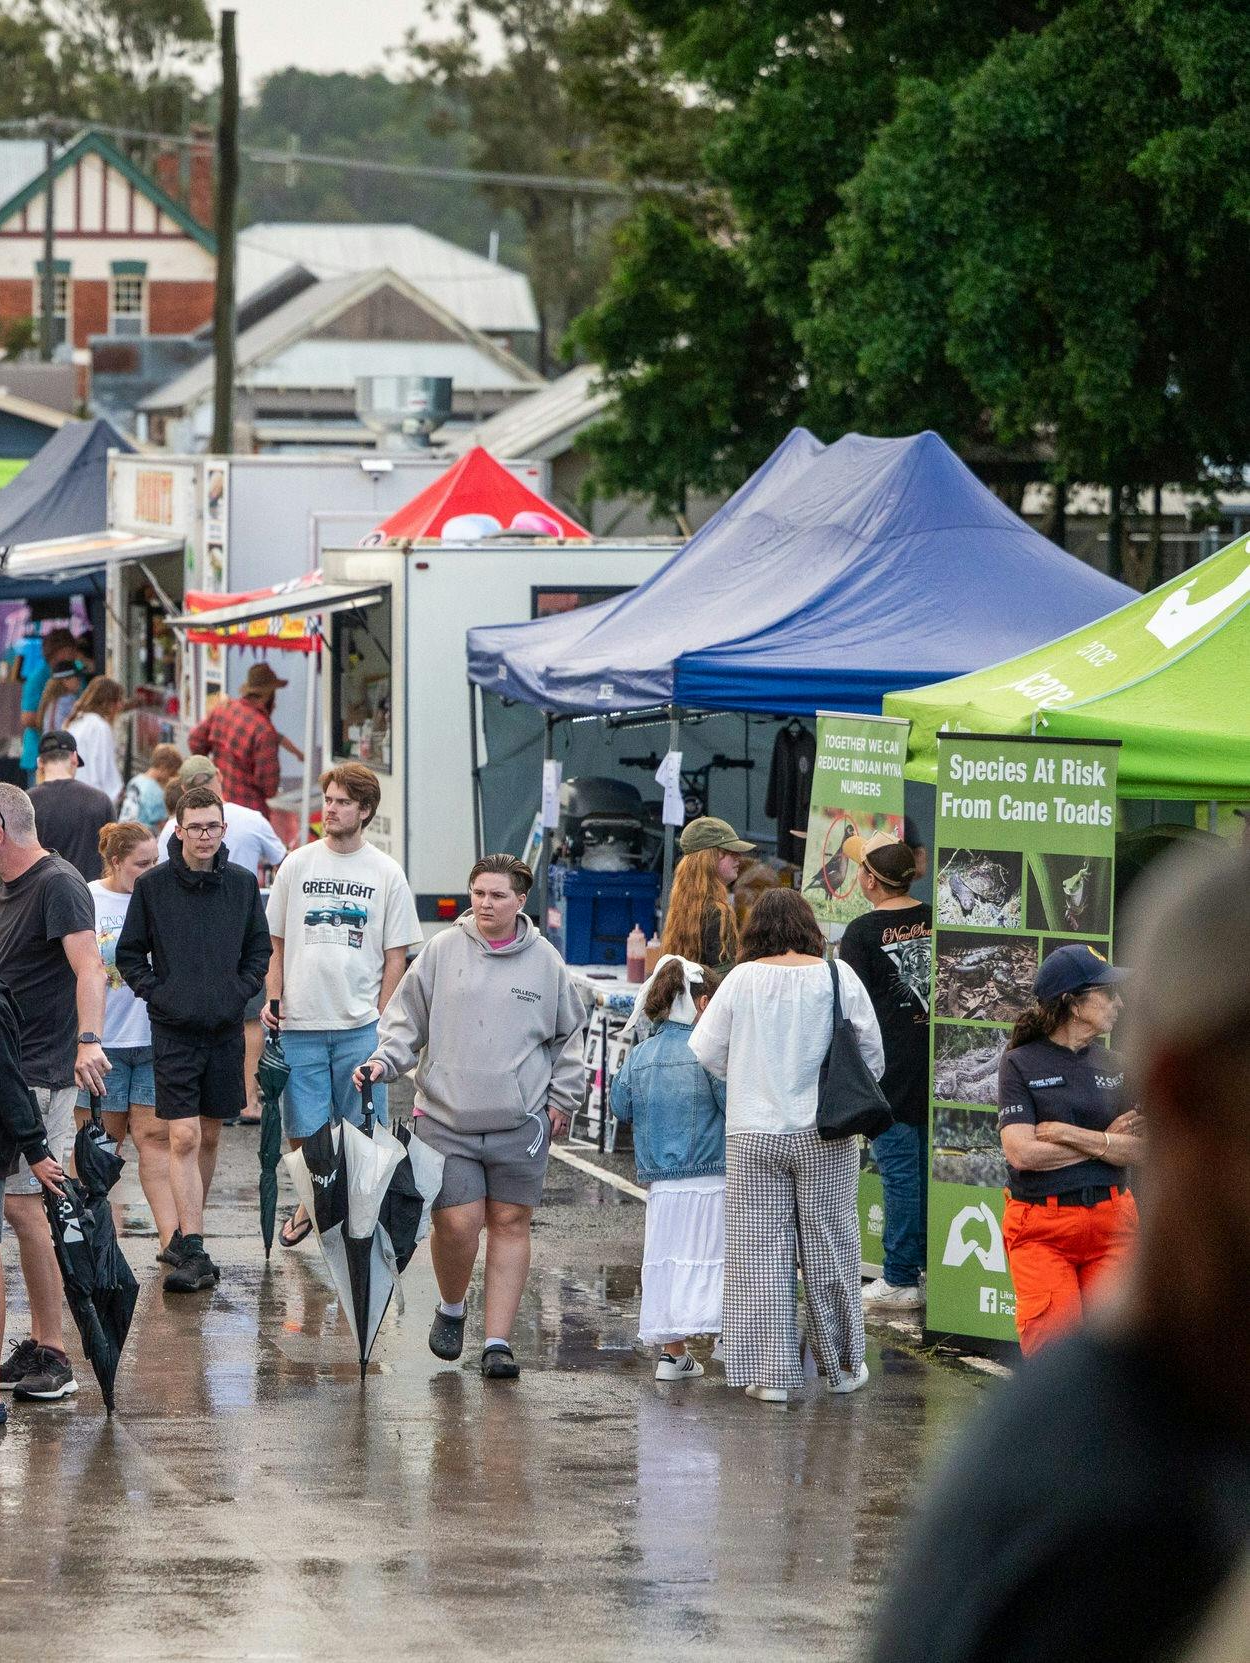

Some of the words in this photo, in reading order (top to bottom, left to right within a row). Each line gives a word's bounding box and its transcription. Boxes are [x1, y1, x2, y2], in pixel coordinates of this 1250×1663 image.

[824, 734, 867, 752] TOGETHER
[868, 738, 882, 753] WE
[883, 740, 900, 755] CAN
[817, 755, 850, 772] REDUCE
[851, 759, 881, 775] INDIAN
[882, 762, 902, 778] MYNA
[950, 753, 1027, 786] Species
[1032, 757, 1056, 784] At
[1061, 759, 1107, 787] Risk
[840, 779, 882, 797] NUMBERS
[941, 792, 991, 819] From
[998, 794, 1048, 822] Cane
[1053, 797, 1112, 826] Toads
[302, 880, 376, 899] GREENLIGHT
[1000, 1290, 1014, 1300] Like
